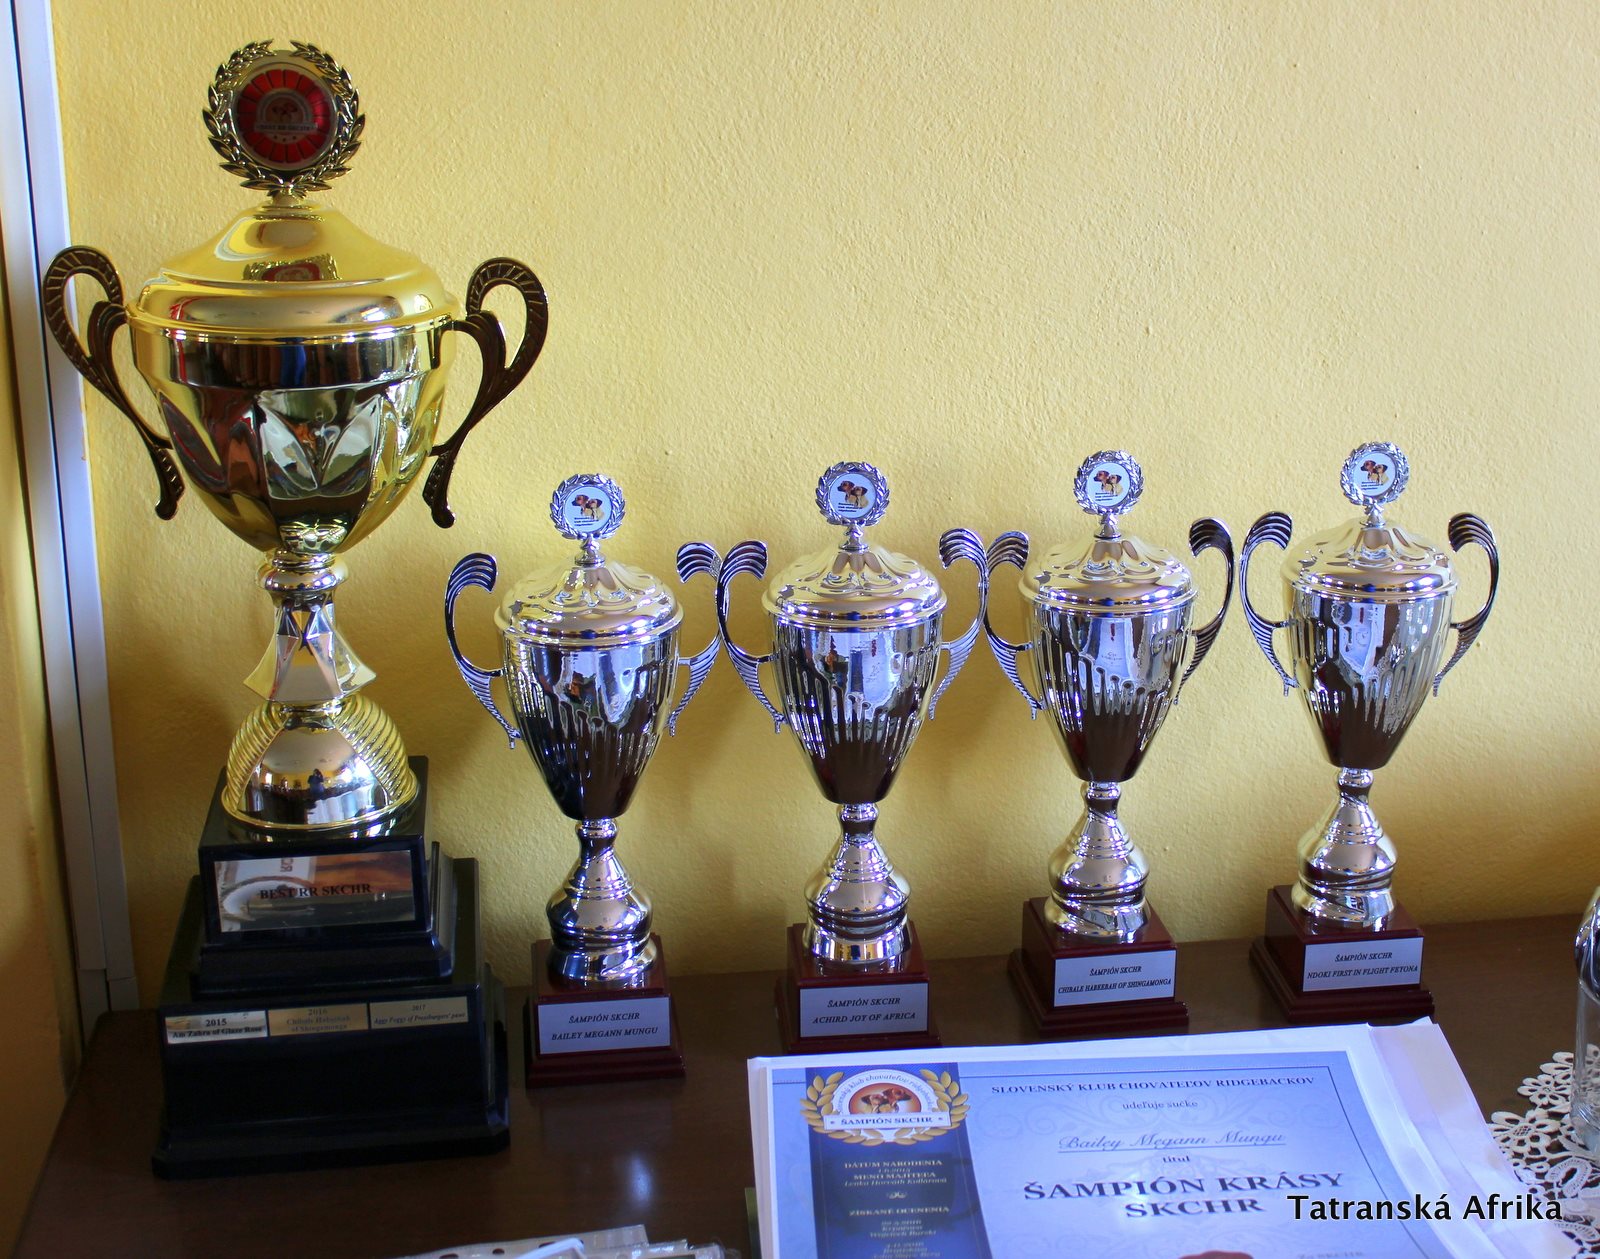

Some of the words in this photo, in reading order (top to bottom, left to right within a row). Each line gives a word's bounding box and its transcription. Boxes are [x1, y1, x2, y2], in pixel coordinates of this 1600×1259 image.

[260, 887, 298, 899] BEST
[300, 887, 318, 897] RR
[322, 883, 371, 896] SKCHR
[1335, 952, 1368, 962] ŠAMPIÓN
[1369, 952, 1392, 960] SKCHR
[1089, 966, 1119, 976] ŠAMPIÓN
[1120, 965, 1142, 974] SKCHR
[1307, 971, 1331, 979] NDOKI
[1332, 969, 1352, 977] FIRST
[1362, 967, 1389, 975] FLIGHT
[1118, 981, 1127, 989] OF
[827, 998, 868, 1008] ŠAMPIÓN
[870, 997, 901, 1006] SKCHR
[205, 1018, 228, 1027] 2015
[568, 1013, 609, 1024] ŠAMPIÓN
[611, 1012, 640, 1021] SKCHR
[812, 1015, 848, 1024] ACHIRD
[849, 1014, 867, 1022] JOY
[868, 1013, 882, 1021] OF
[882, 1012, 916, 1020] AFRICA
[552, 1032, 583, 1040] BAILEY
[584, 1029, 622, 1039] MEGANN
[624, 1027, 658, 1036] MUNGU
[992, 1083, 1074, 1094] SLOVENSKÝ
[1078, 1083, 1116, 1091] KLUB
[1119, 1080, 1212, 1090] CHOVATEĽOV
[1216, 1077, 1314, 1087] RIDGEBACKOV
[1122, 1101, 1164, 1110] udeľuje
[841, 1115, 892, 1125] ŠAMPIÓN
[894, 1116, 933, 1124] SKCHR
[1058, 1135, 1124, 1150] Bailey
[1130, 1133, 1209, 1149] Megann
[1215, 1131, 1286, 1146] Mungu
[1162, 1155, 1191, 1163] titul
[1024, 1176, 1205, 1200] ŠAMPIÓN
[1217, 1171, 1344, 1191] KRÁSY
[1126, 1198, 1265, 1217] SKCHR
